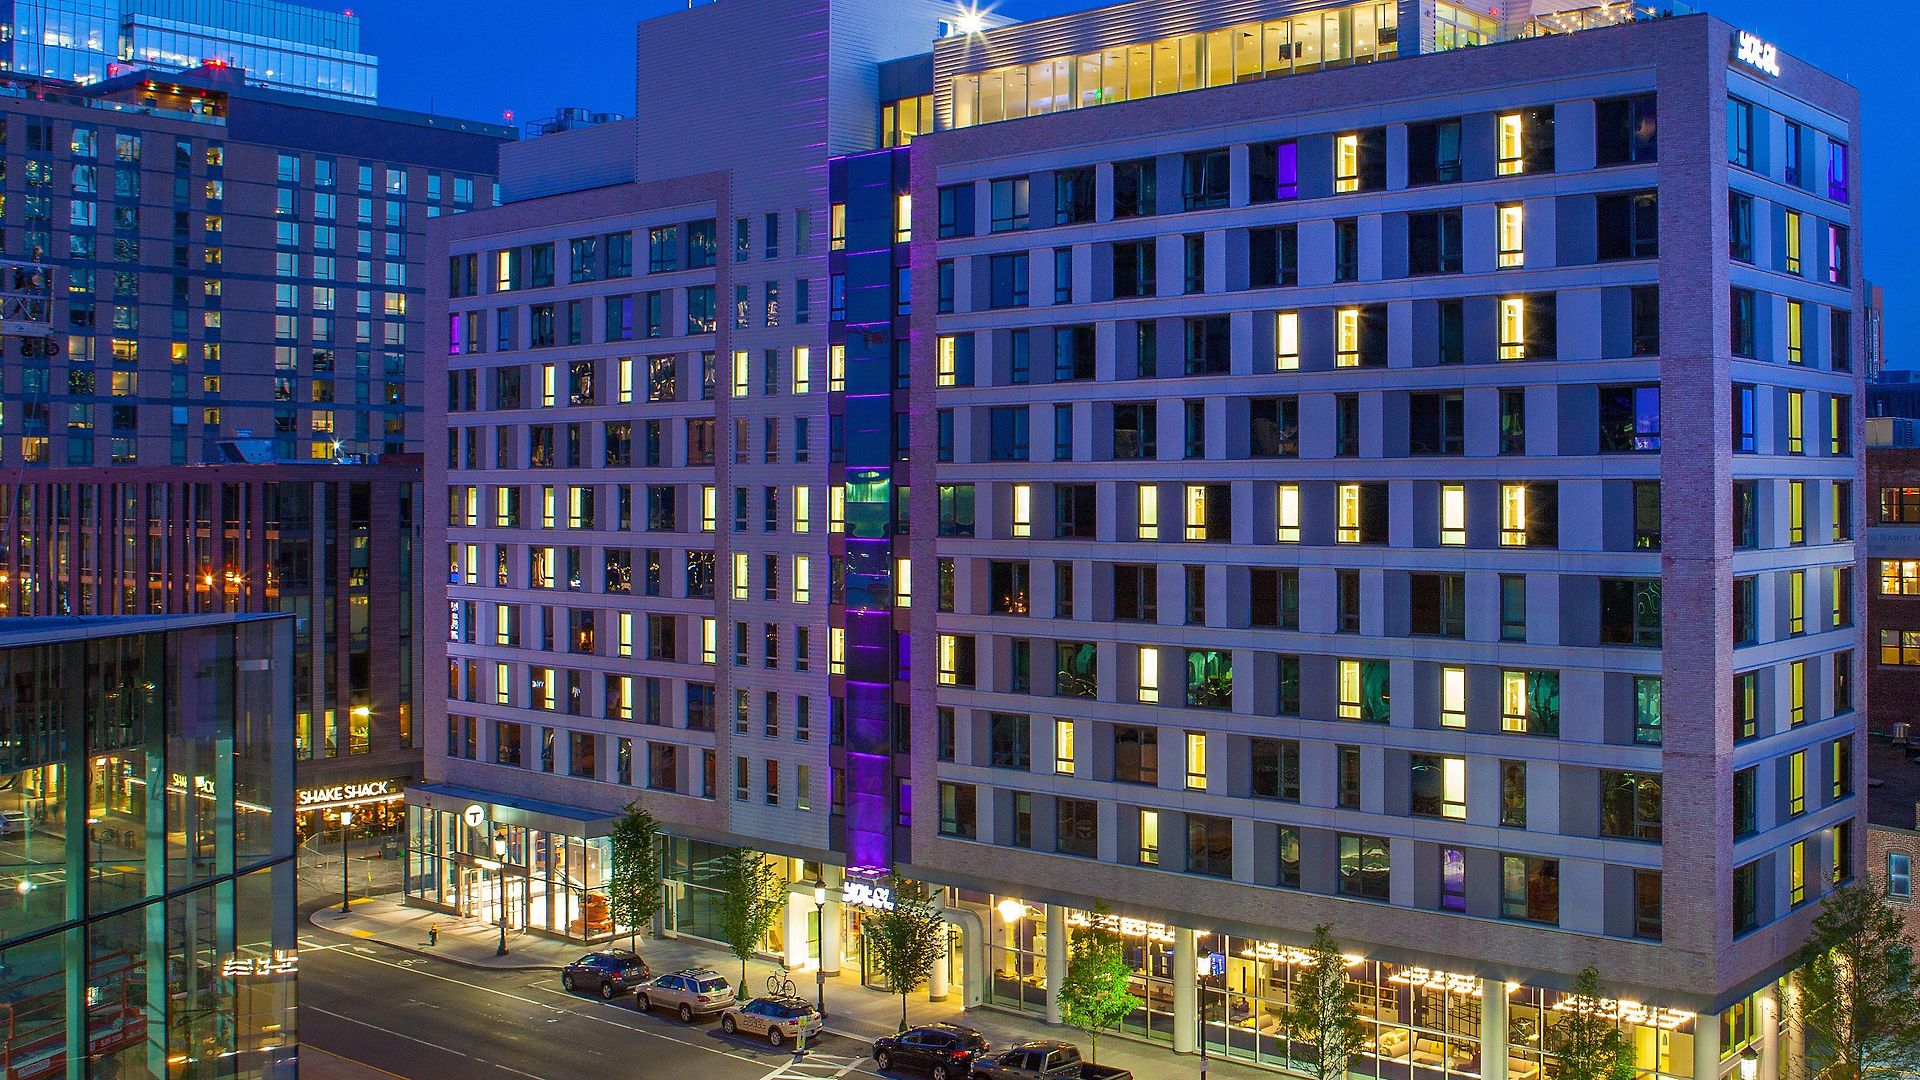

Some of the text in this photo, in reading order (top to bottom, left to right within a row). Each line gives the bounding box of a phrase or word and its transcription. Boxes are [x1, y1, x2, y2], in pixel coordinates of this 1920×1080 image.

[300, 781, 388, 804] SHAKE SHACK
[469, 811, 481, 824] T
